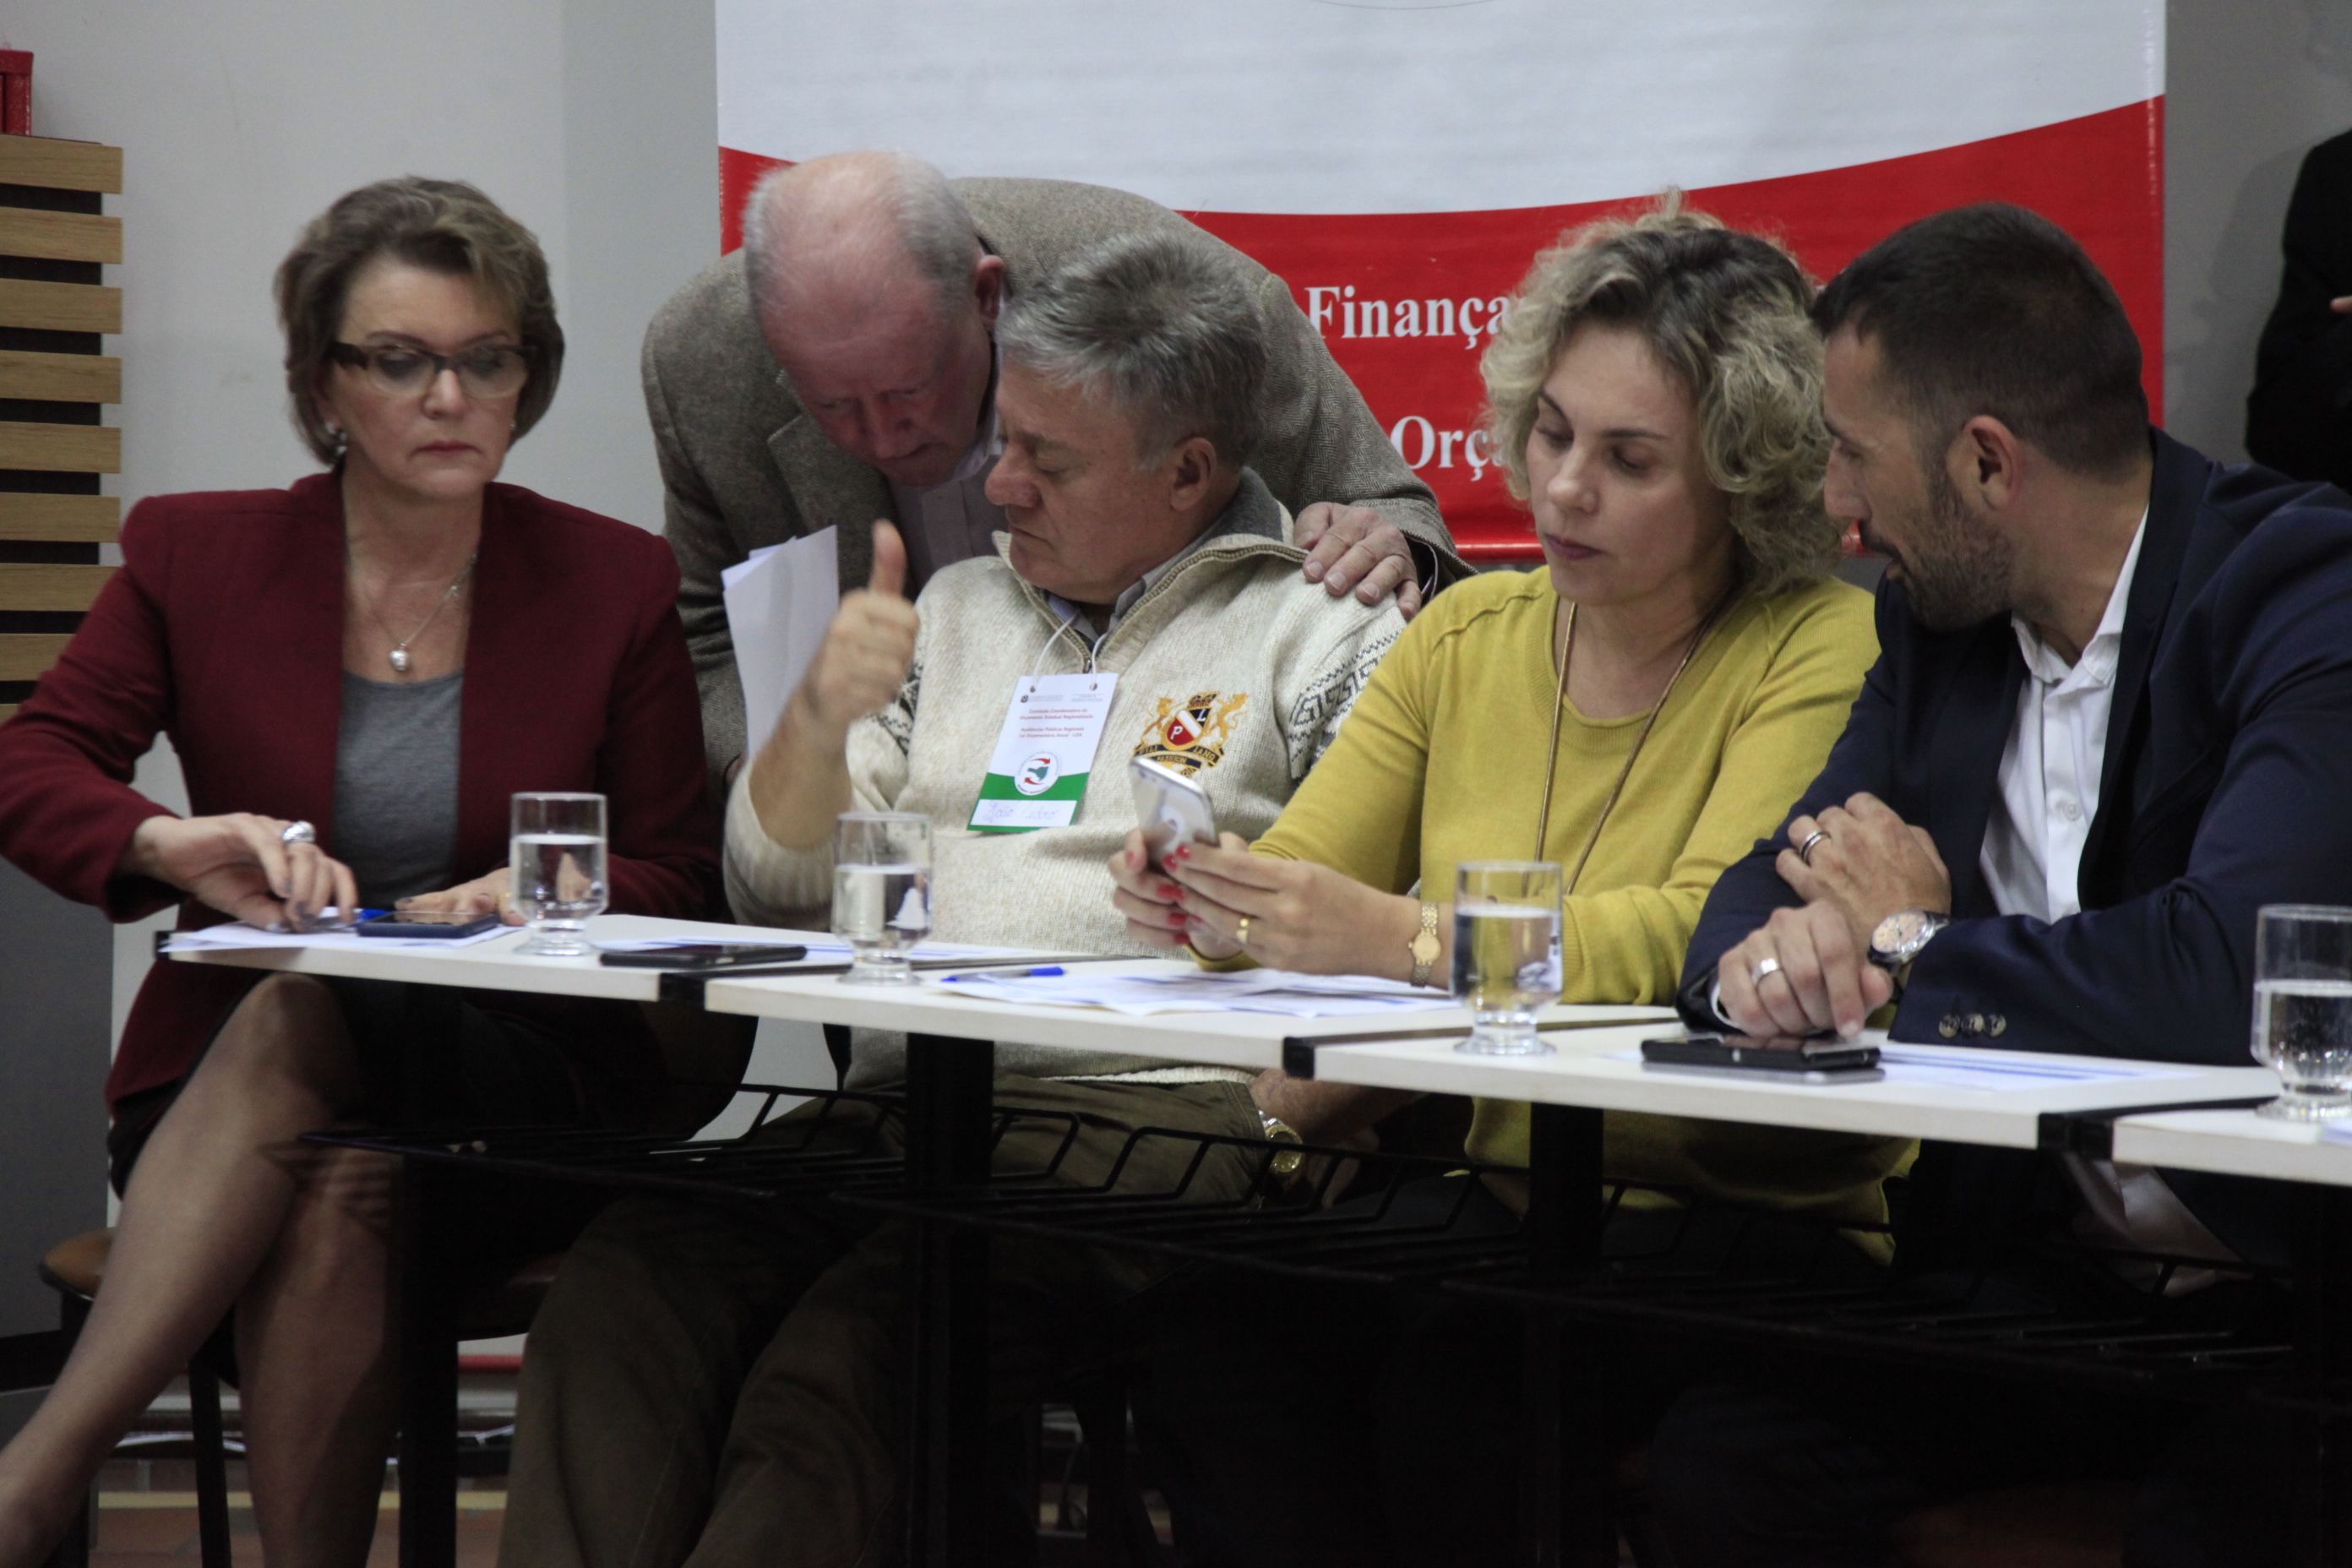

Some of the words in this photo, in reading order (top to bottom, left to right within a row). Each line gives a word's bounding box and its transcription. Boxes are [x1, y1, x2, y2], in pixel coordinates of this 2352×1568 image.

[1304, 285, 1511, 349] Finança
[1196, 708, 1206, 721] L
[1170, 725, 1183, 739] P
[1157, 755, 1188, 765] FASHION
